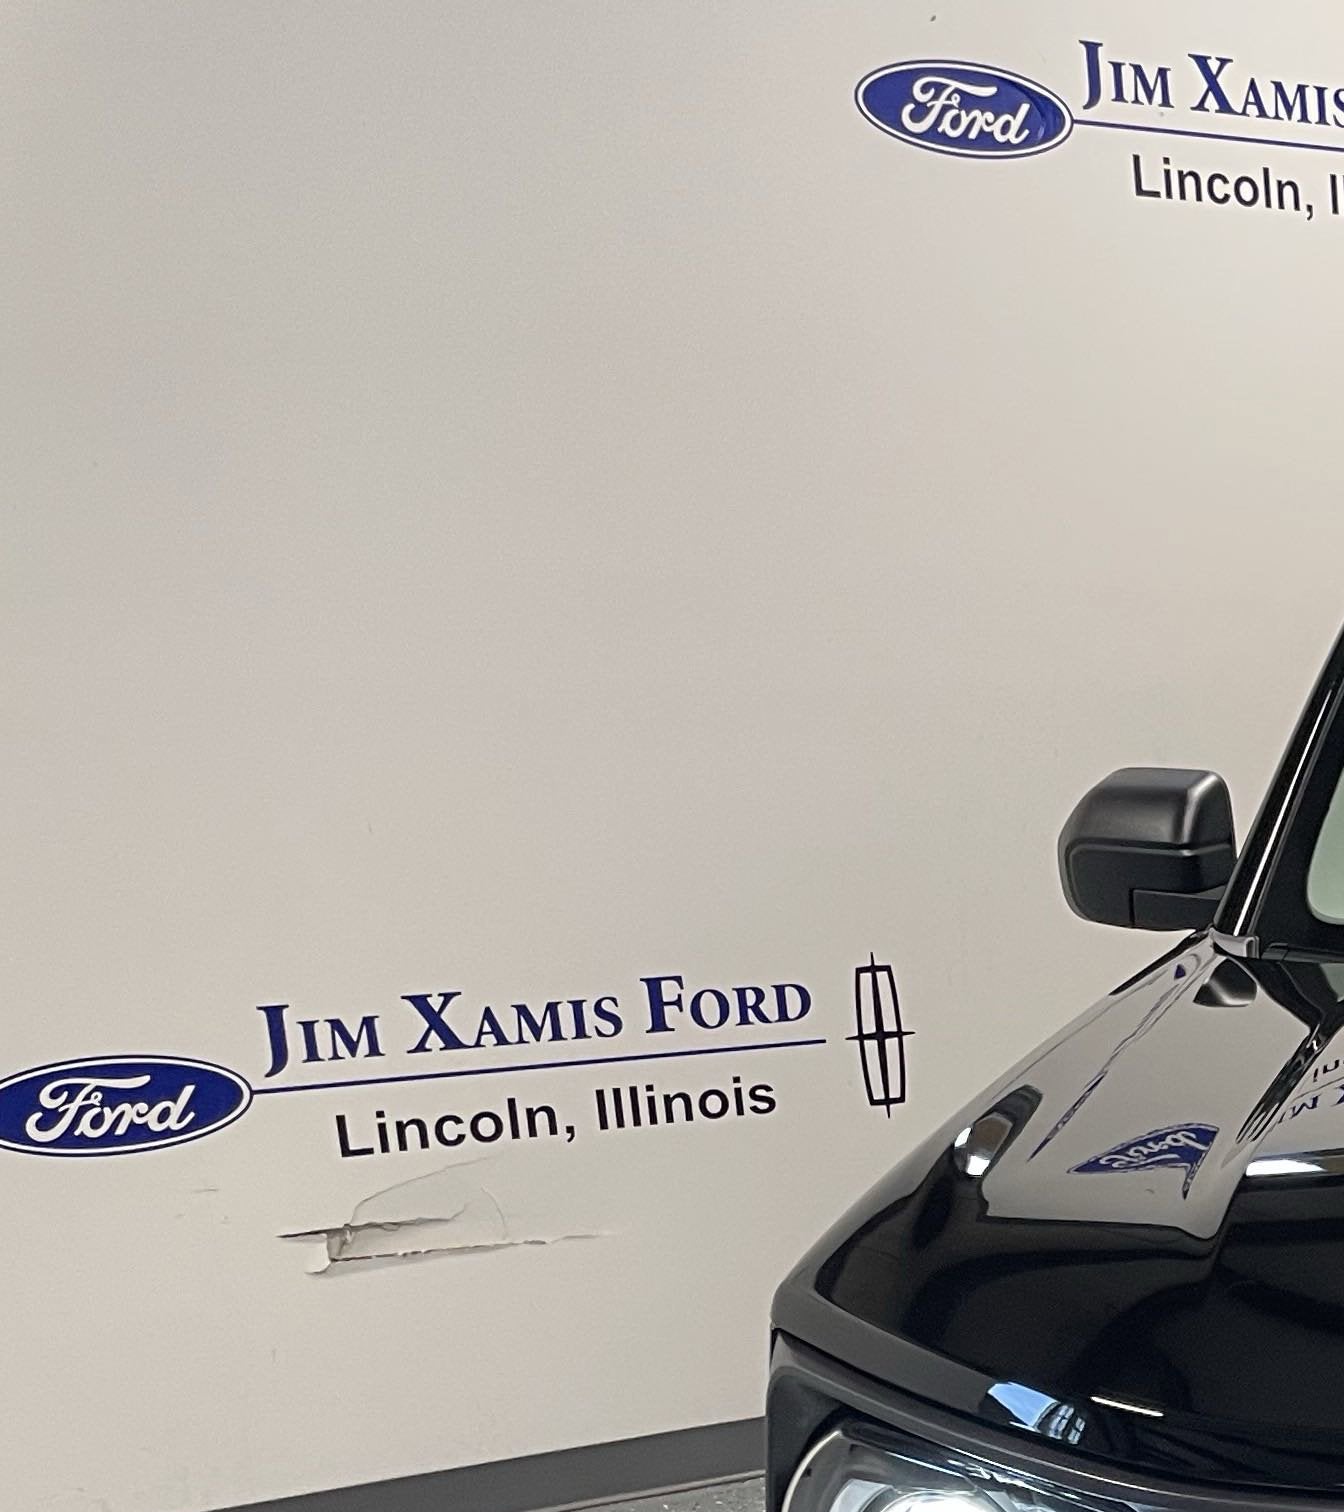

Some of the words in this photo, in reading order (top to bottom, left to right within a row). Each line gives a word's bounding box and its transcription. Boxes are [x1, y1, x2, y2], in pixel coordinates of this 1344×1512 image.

[1079, 40, 1174, 109] JIM
[902, 75, 1031, 144] Ford
[1133, 154, 1313, 220] Lincoln,
[256, 1005, 385, 1077] JIM
[401, 992, 622, 1053] XAMIS
[640, 976, 811, 1033] FORD
[24, 1074, 196, 1141] Ford
[336, 1098, 575, 1157] Lincoln,
[596, 1076, 776, 1130] Illinois
